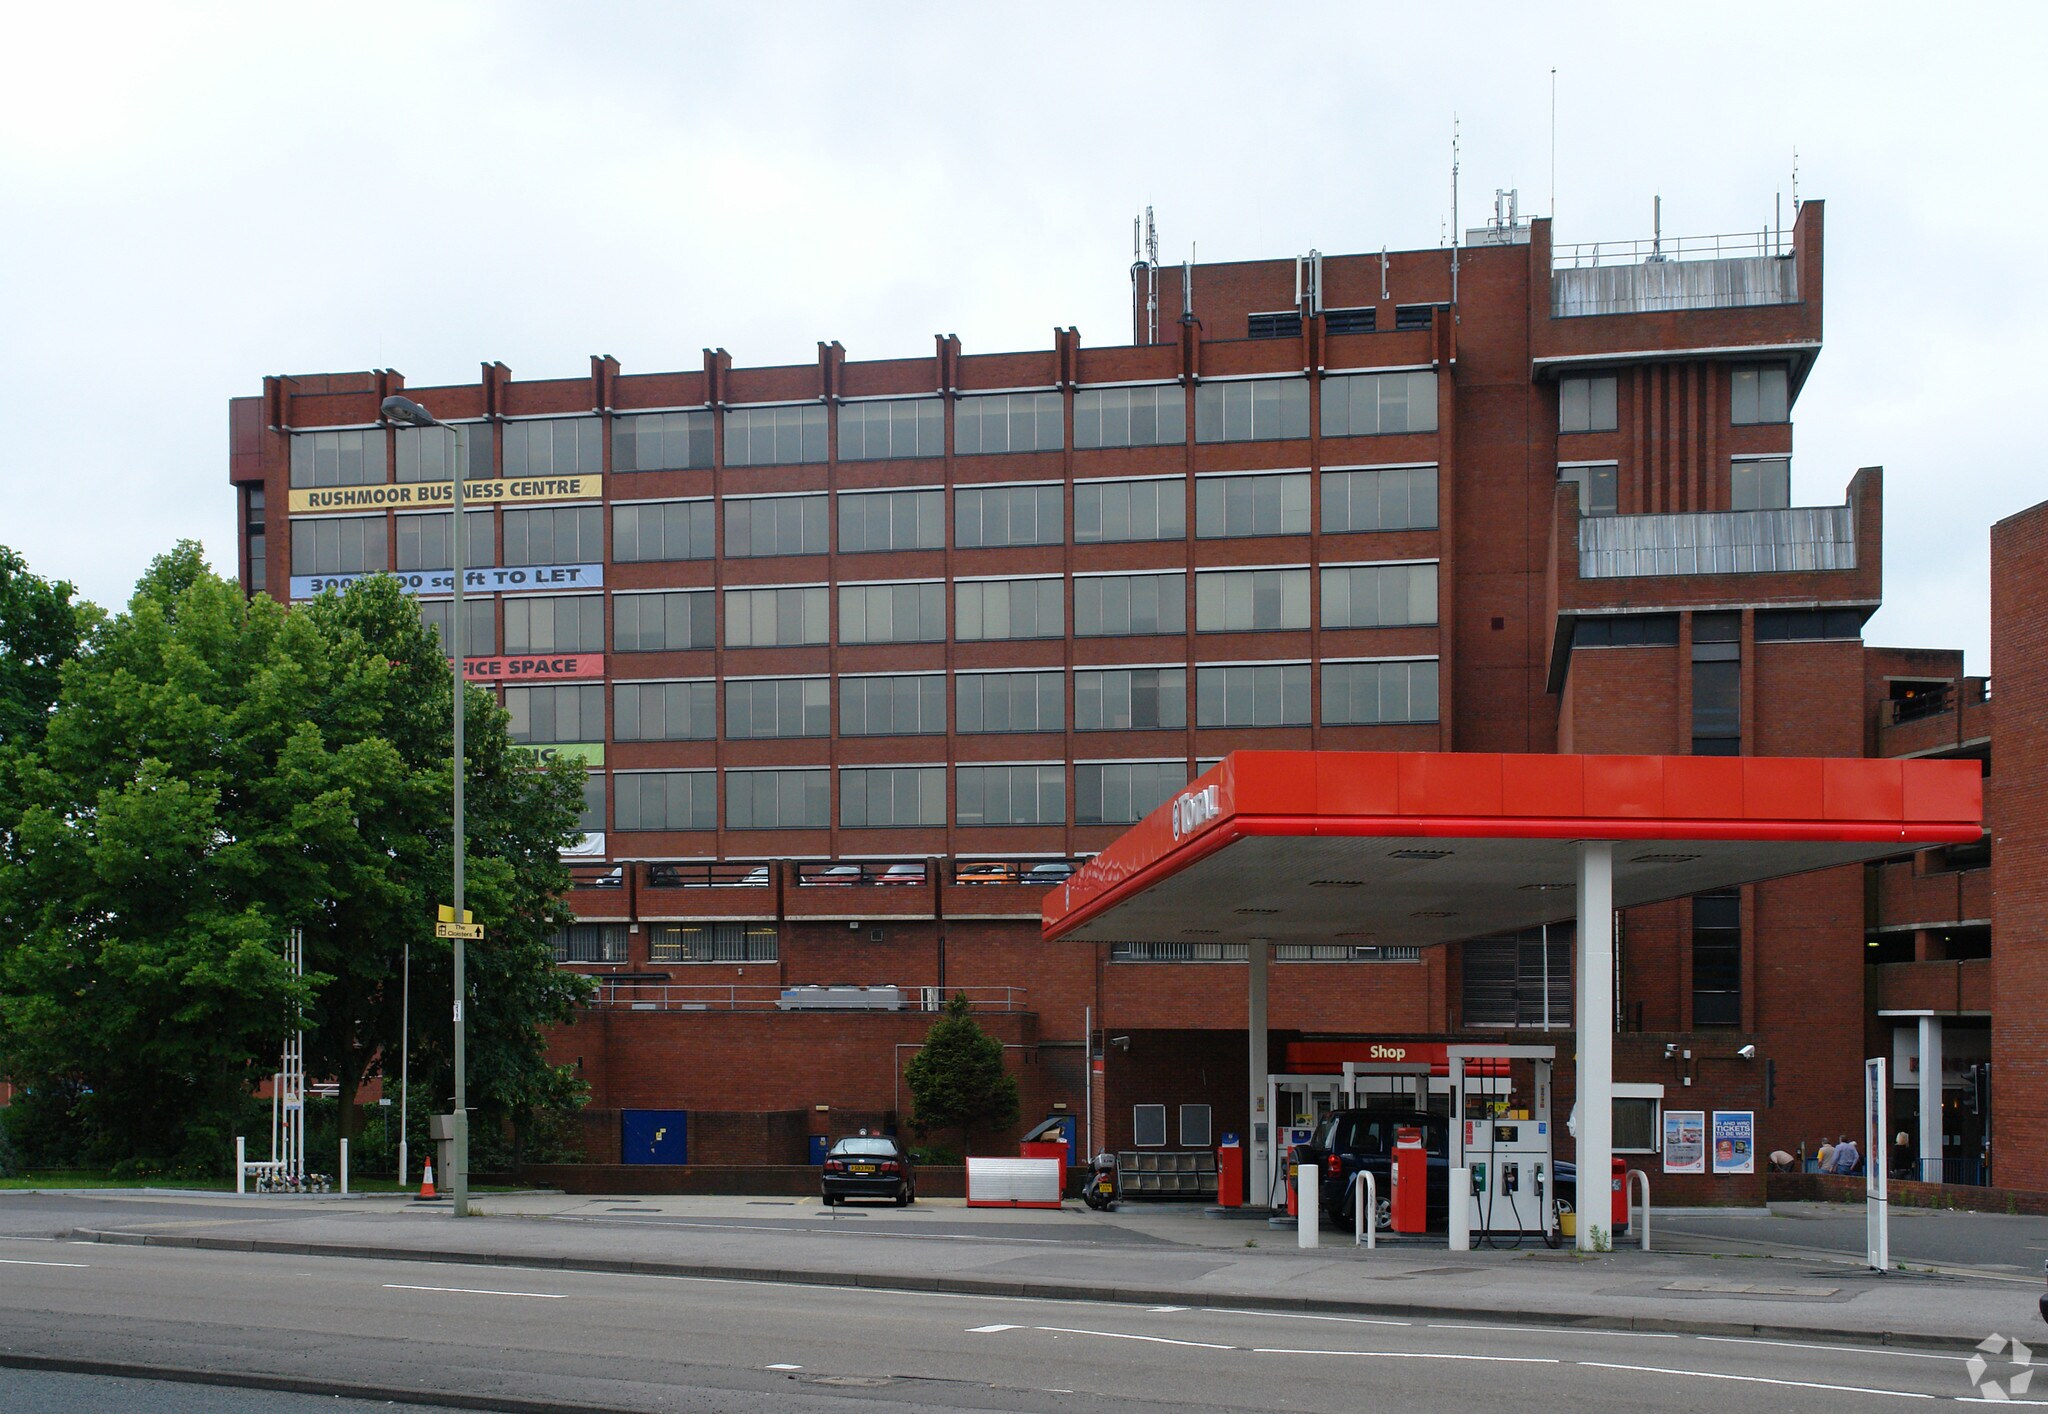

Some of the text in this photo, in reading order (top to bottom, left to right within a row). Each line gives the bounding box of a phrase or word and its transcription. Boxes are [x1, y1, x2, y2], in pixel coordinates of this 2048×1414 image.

[309, 479, 581, 506] RUSHMOOR BUSNESS CENTRE
[431, 576, 455, 590] sq
[465, 571, 485, 586] ft
[493, 570, 527, 584] TO
[536, 568, 581, 582] LET
[508, 659, 577, 674] SPACE
[1178, 784, 1222, 835] TOTAL
[1370, 1044, 1406, 1062] Shop
